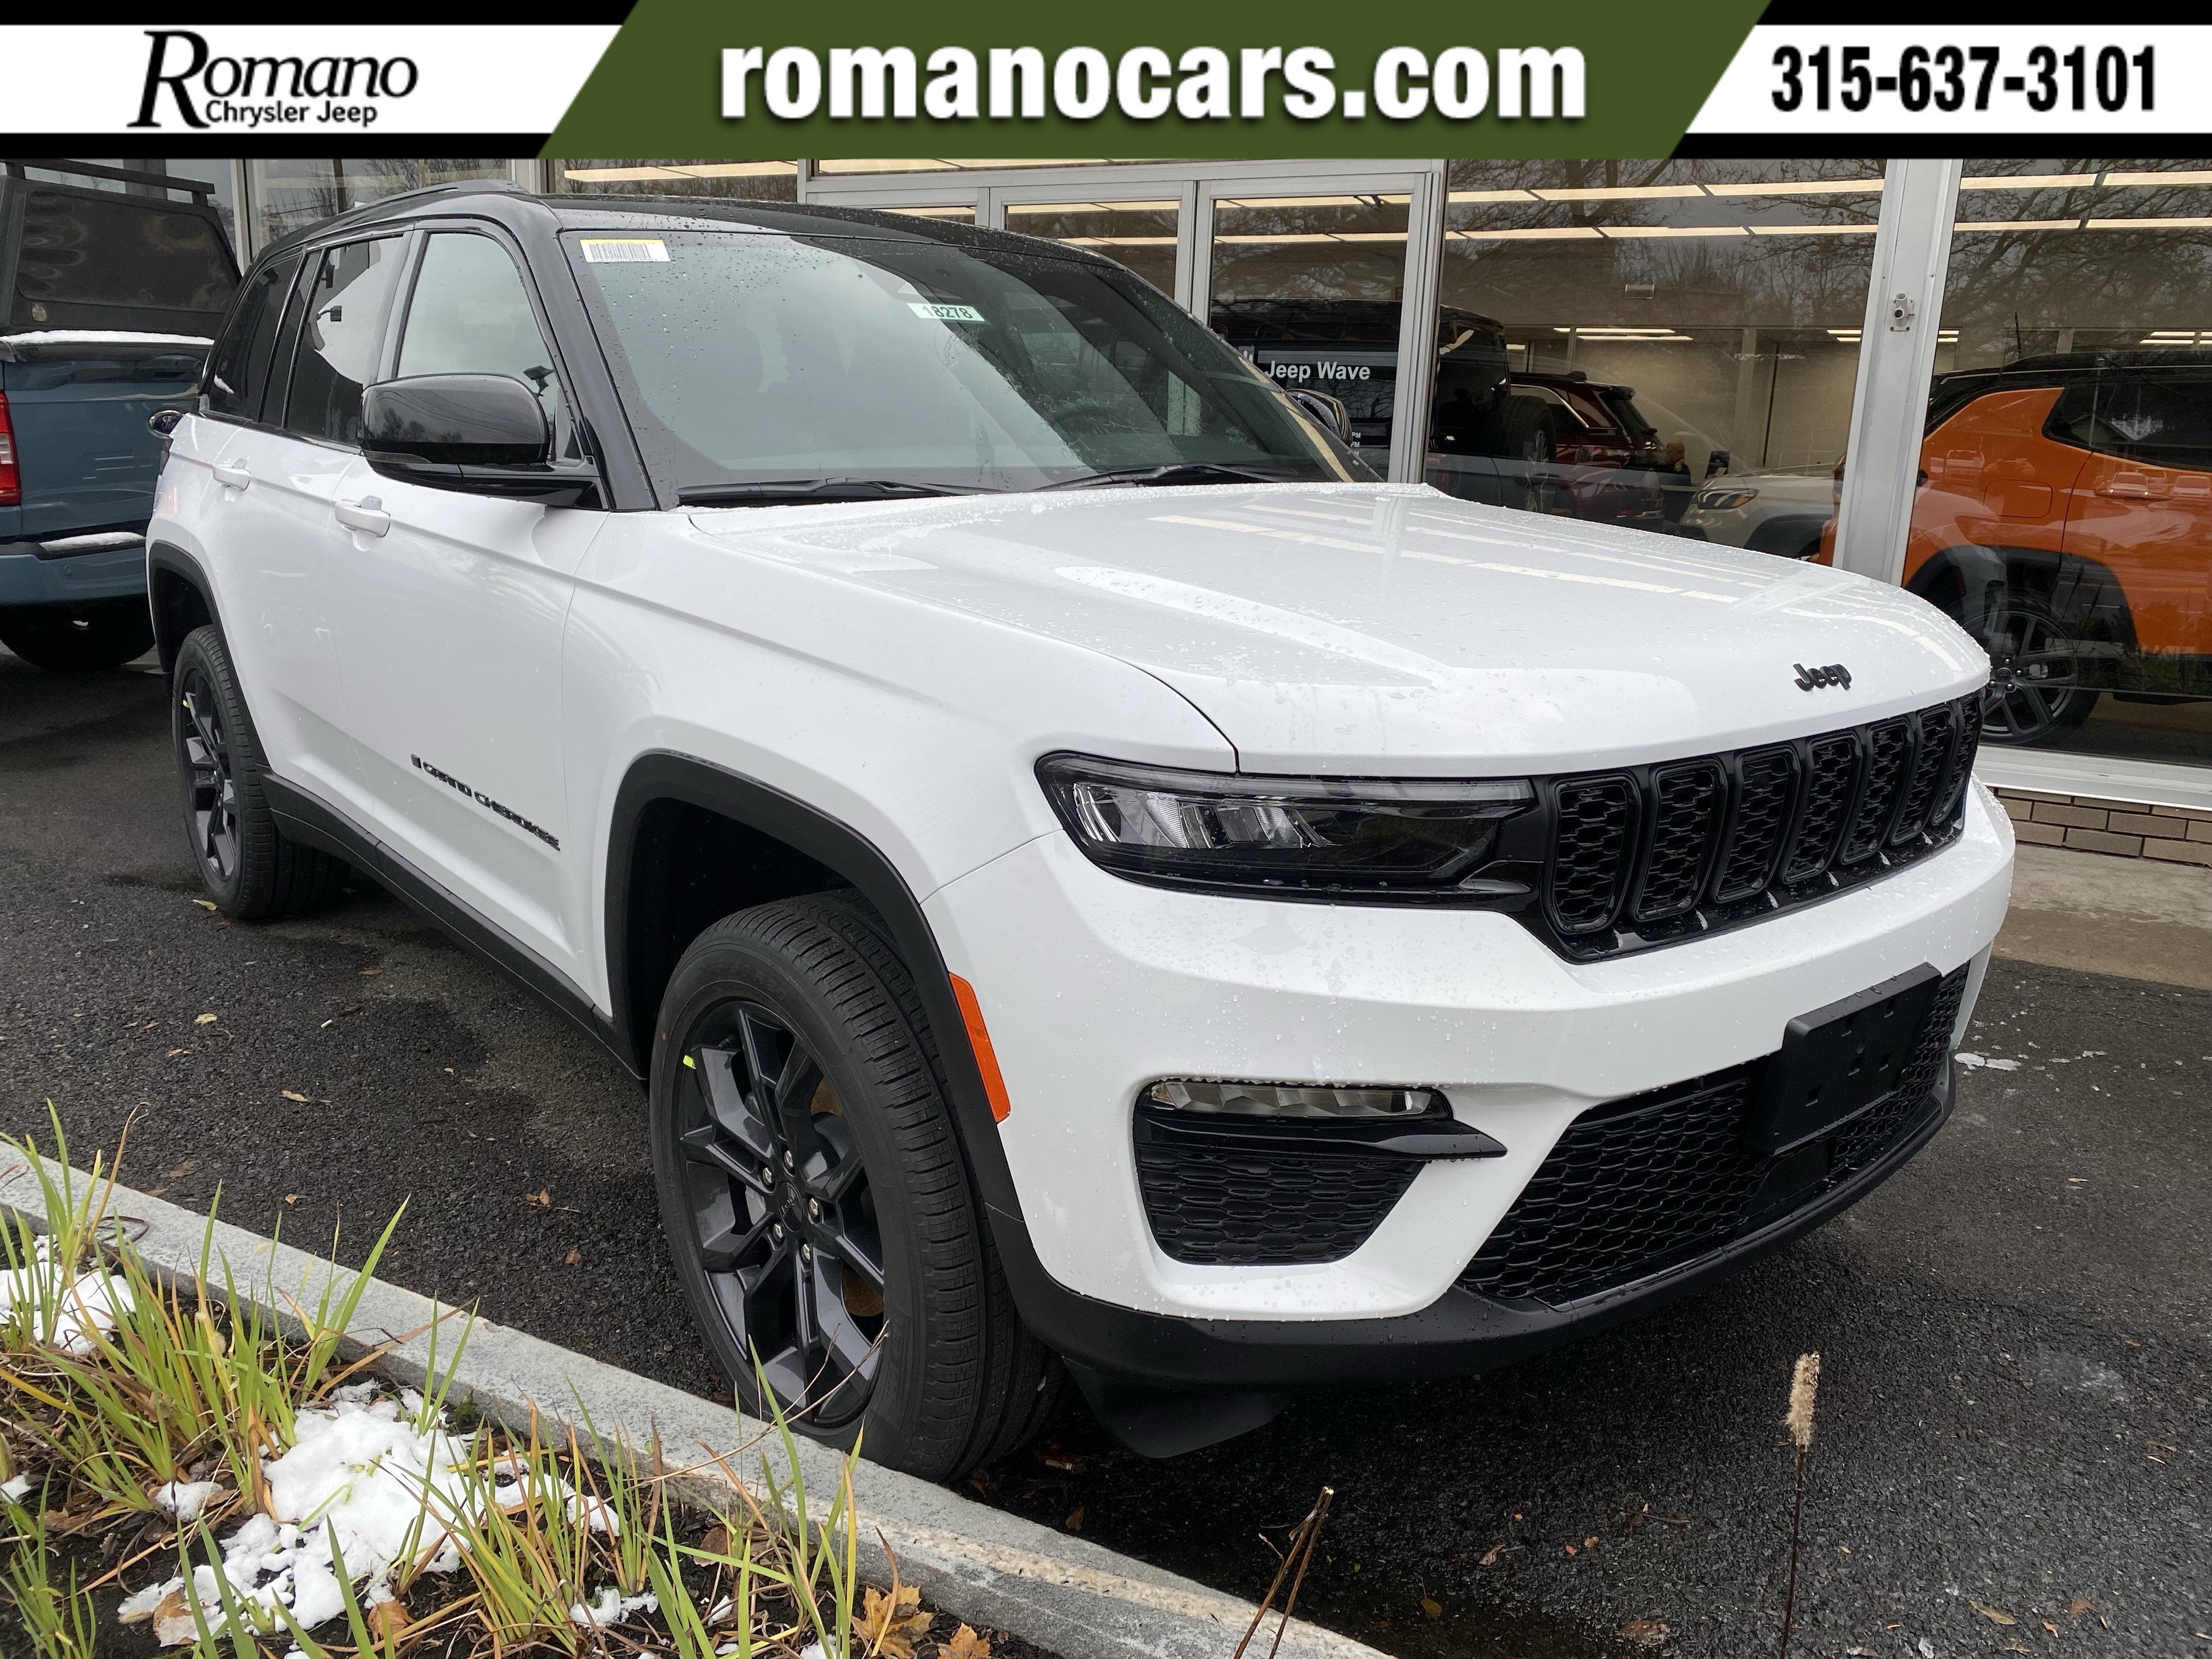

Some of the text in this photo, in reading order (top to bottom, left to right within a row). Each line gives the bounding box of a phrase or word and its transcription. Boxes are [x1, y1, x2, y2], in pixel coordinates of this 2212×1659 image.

[922, 306, 973, 319] 18278
[1265, 360, 1370, 383] Jeep Wave
[1792, 663, 1852, 692] Jeep
